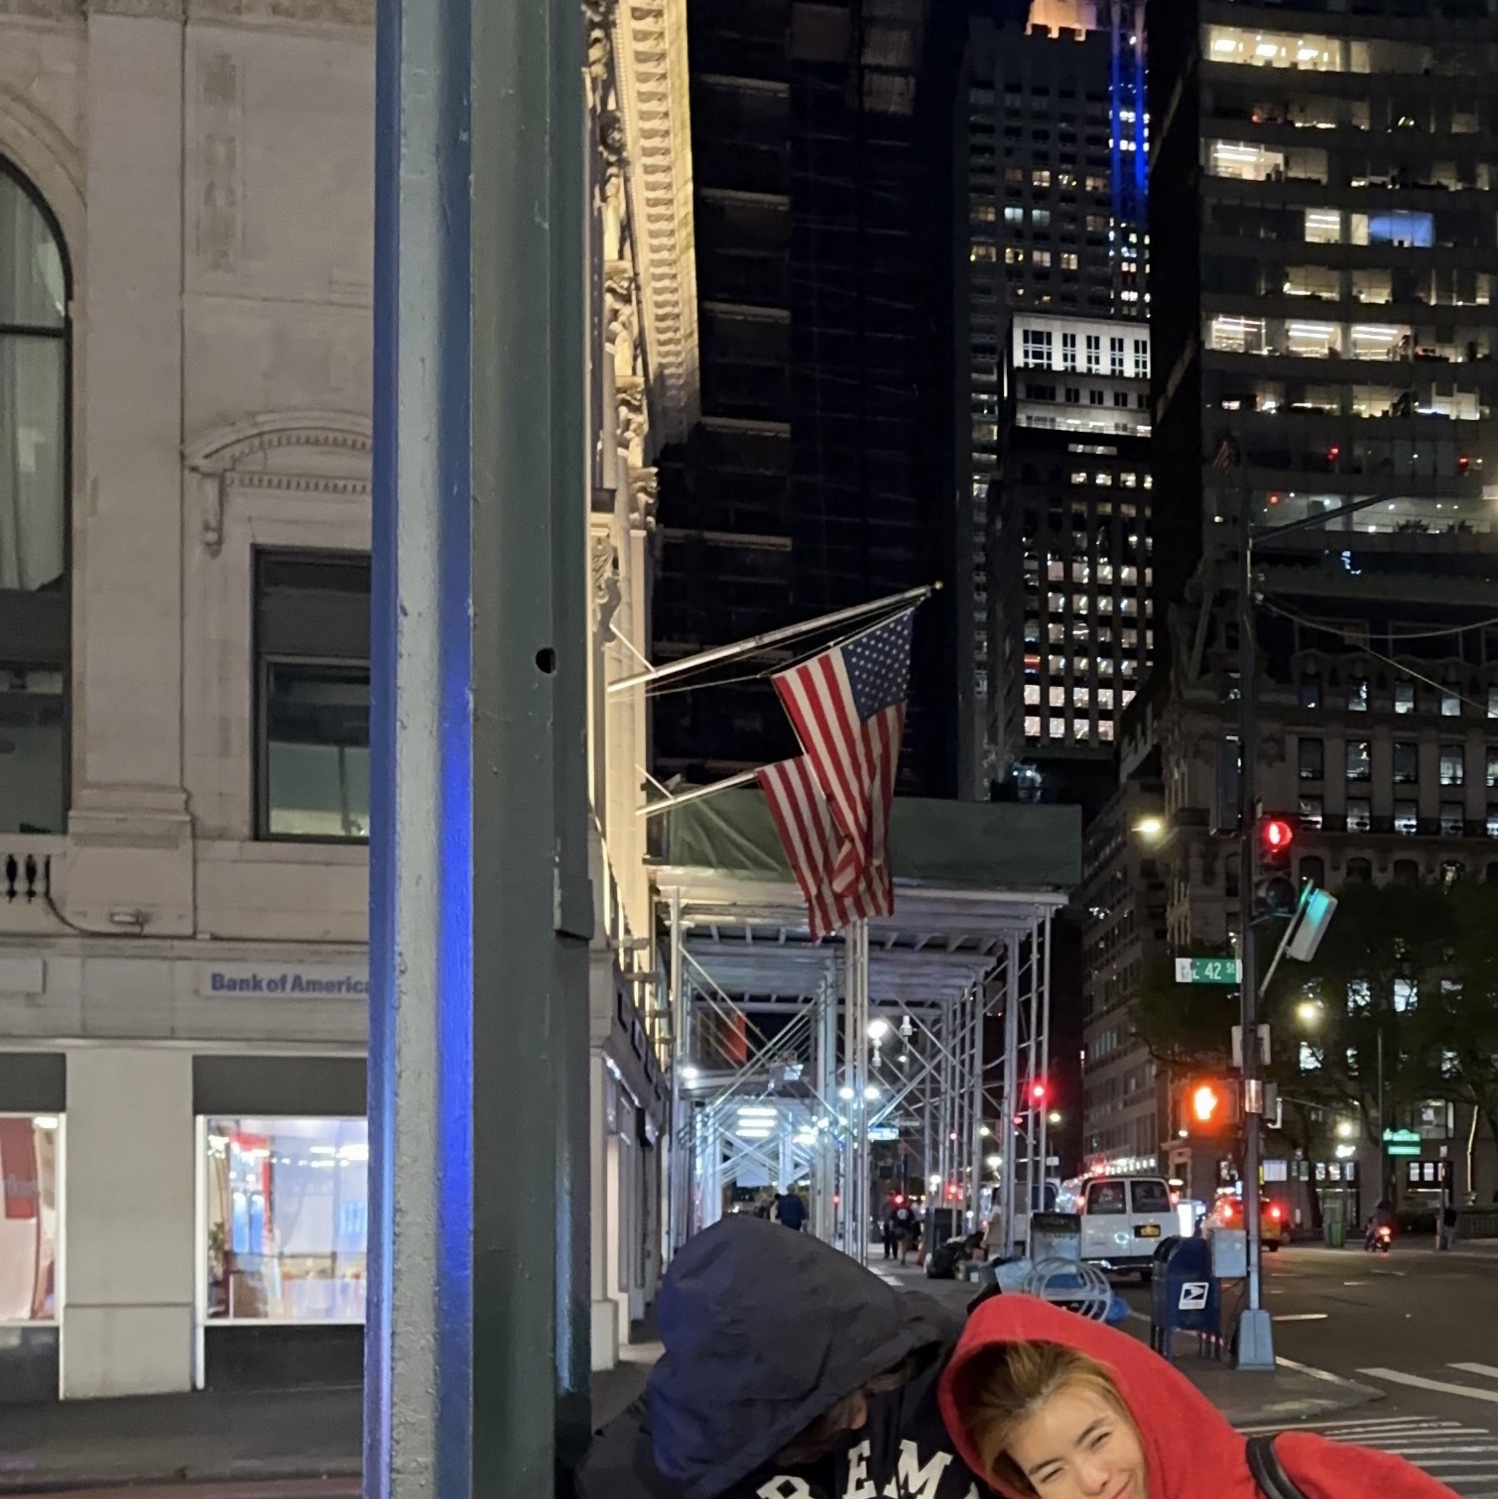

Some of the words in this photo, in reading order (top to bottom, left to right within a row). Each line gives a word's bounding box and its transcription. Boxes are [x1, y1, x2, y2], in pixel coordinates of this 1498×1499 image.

[1204, 962, 1222, 980] 42
[211, 973, 263, 992] Bank
[266, 974, 288, 992] of
